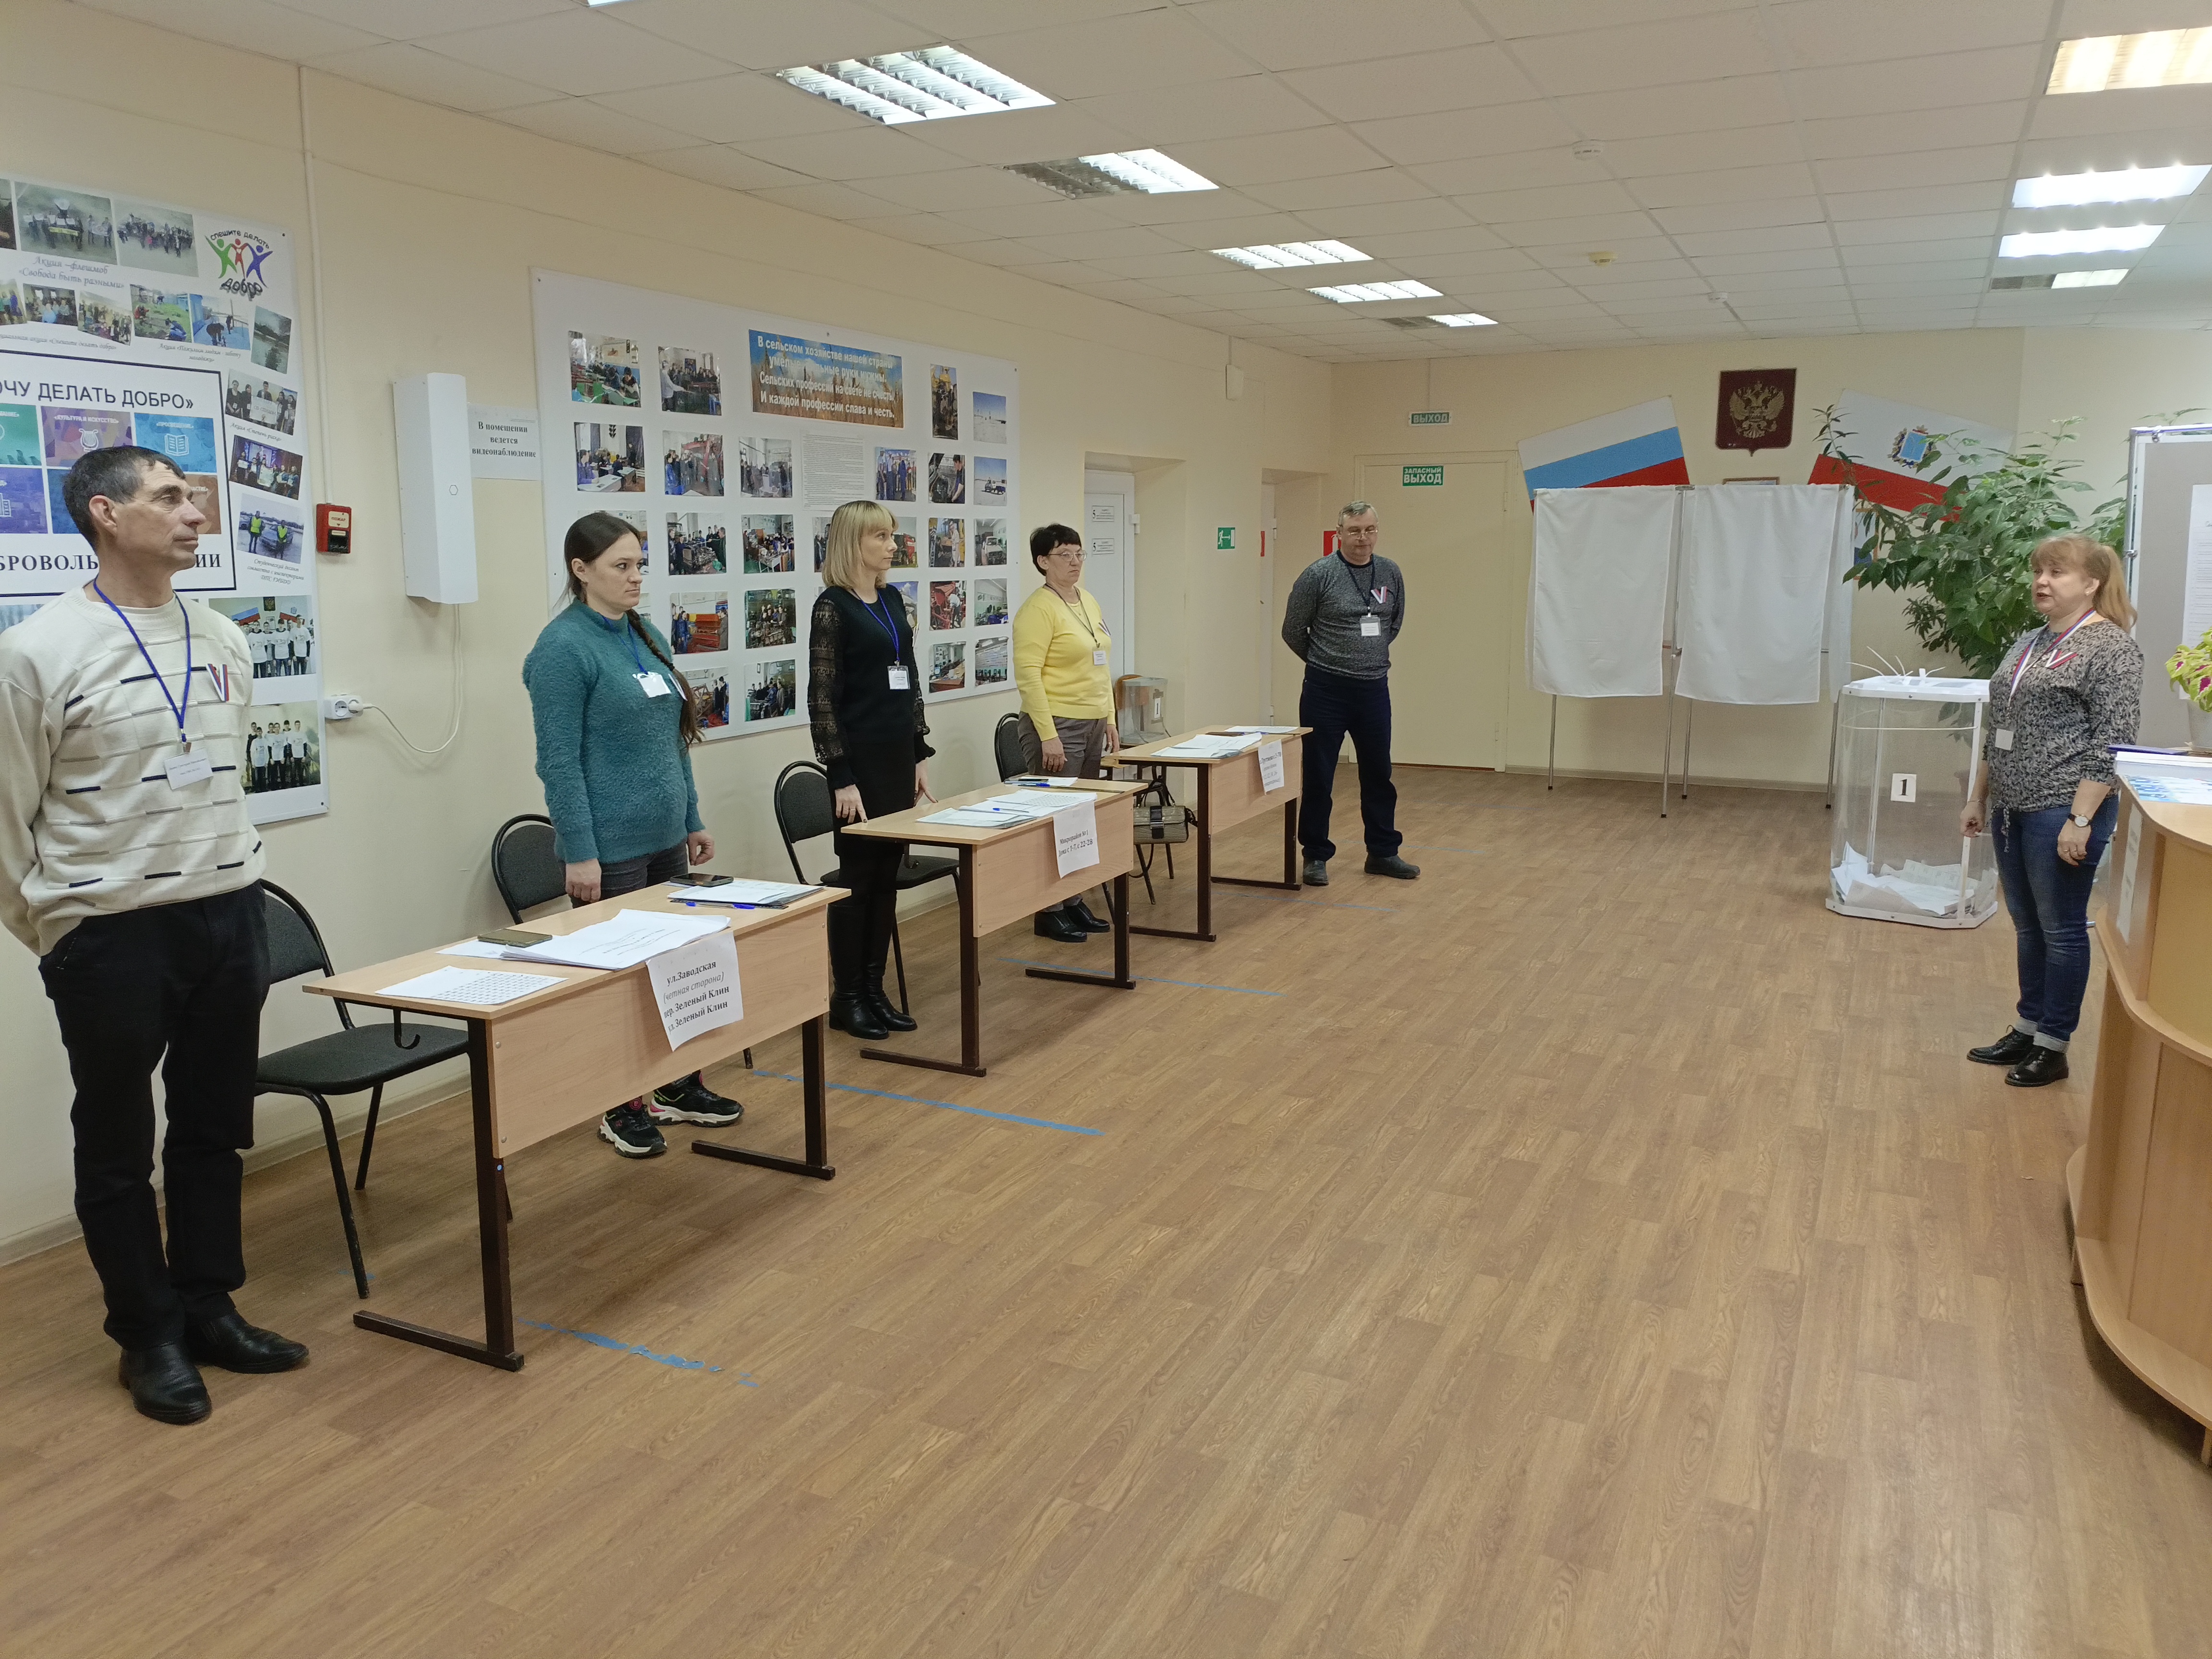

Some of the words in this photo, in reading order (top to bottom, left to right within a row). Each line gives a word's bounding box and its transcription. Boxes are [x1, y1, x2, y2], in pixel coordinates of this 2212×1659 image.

[757, 336, 764, 347] В
[766, 339, 803, 354] сельском
[805, 347, 842, 361] хозяйстве
[844, 353, 867, 365] нашей
[842, 367, 858, 379] руки
[0, 379, 31, 397] ЧУ
[38, 383, 116, 404] ДЕЛАТЬ
[122, 389, 193, 409] ДОБРО»
[759, 371, 794, 388] Сельских
[835, 385, 844, 394] на
[844, 386, 863, 397] свете
[760, 390, 767, 403] И
[769, 394, 799, 408] каждой
[801, 397, 843, 412] профессии
[845, 404, 866, 415] слава
[868, 407, 873, 416] и
[874, 408, 895, 418] честь.
[478, 421, 484, 430] В
[485, 423, 528, 433] помещении
[1413, 413, 1448, 423] ВЫХОД
[490, 436, 518, 445] ведется
[472, 447, 537, 458] видеонаблюдение
[1403, 473, 1442, 484] ВЫХОД
[1899, 779, 1909, 796] 1
[1080, 838, 1093, 848] 22-28
[666, 961, 717, 986] ул.Заводская
[663, 985, 690, 1004] (четная
[691, 972, 725, 990] сторона)
[663, 1009, 675, 1019] пер.
[674, 992, 707, 1012] Зеленый
[709, 986, 730, 998] Клин
[674, 1008, 706, 1028] Зеленый
[707, 1001, 728, 1013] Клин
